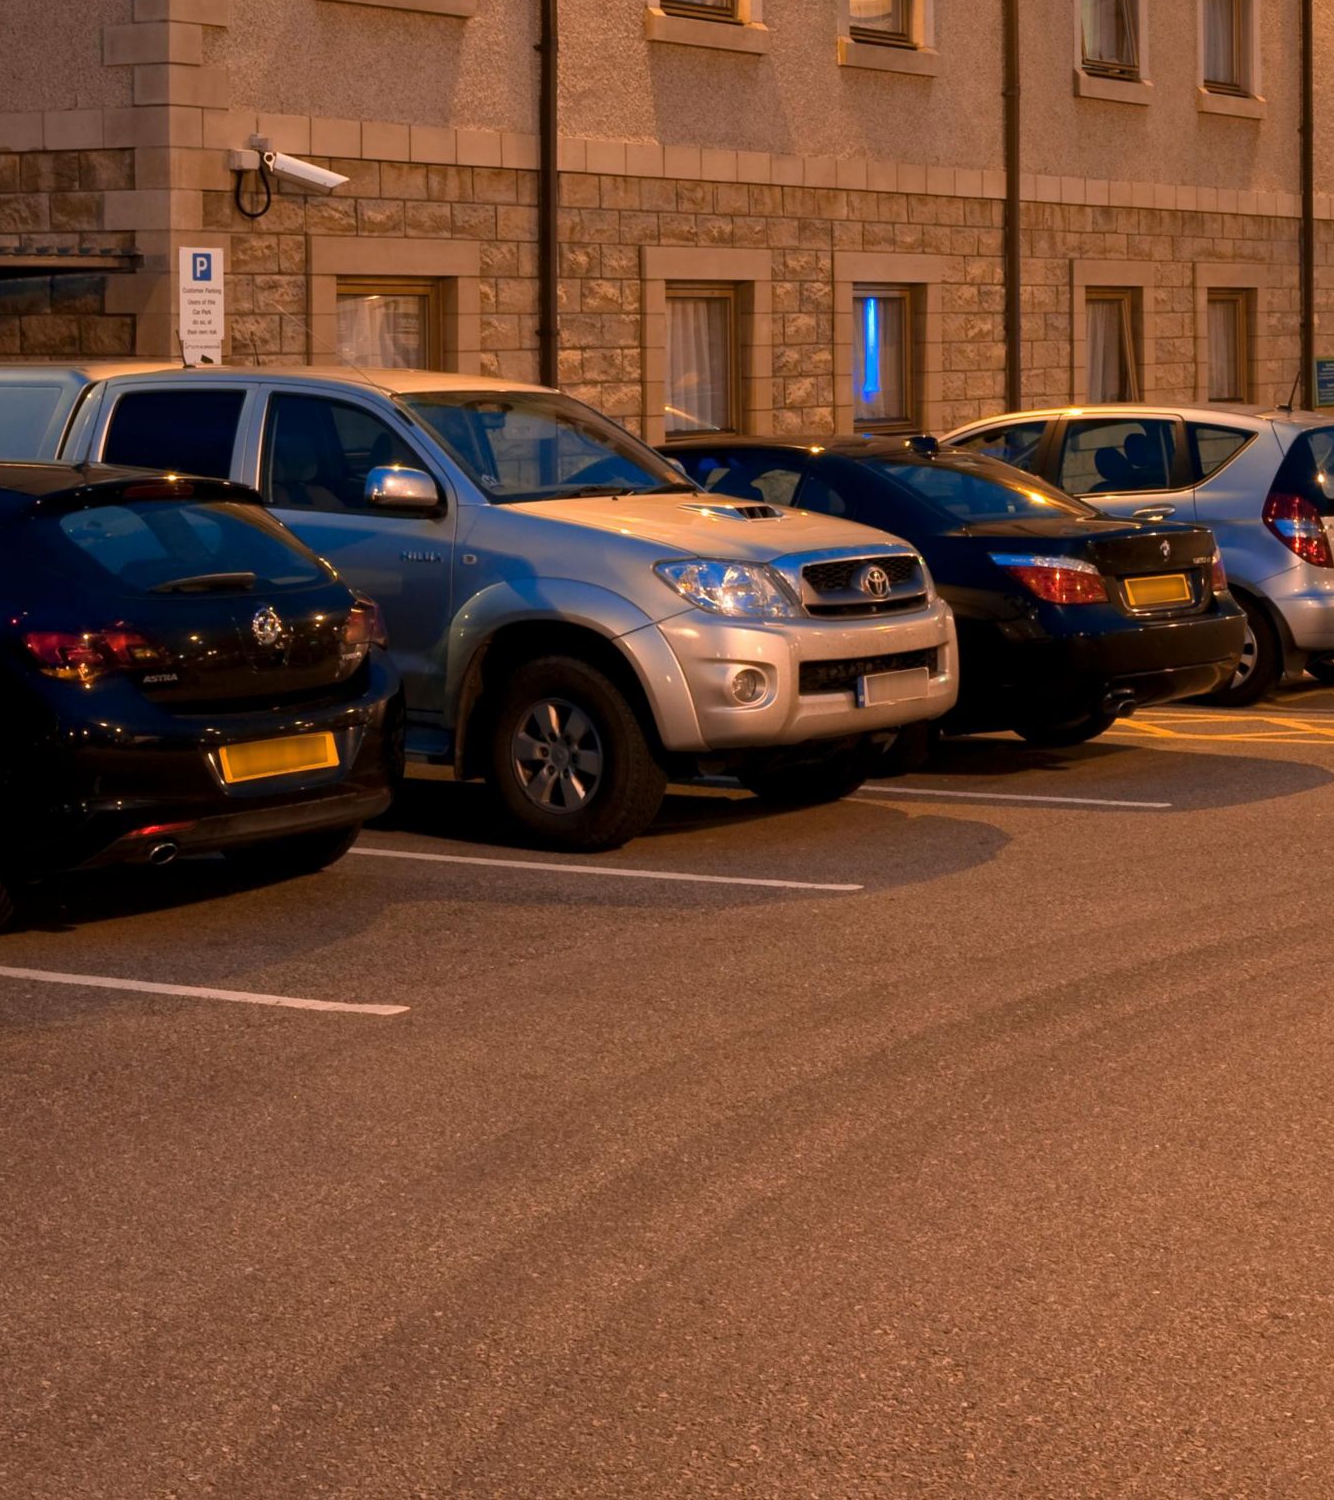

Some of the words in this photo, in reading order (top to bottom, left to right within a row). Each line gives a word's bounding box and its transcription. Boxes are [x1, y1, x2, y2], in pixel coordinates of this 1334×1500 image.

[196, 257, 208, 278] P
[205, 287, 222, 295] Parking
[401, 550, 444, 563] HILUX
[143, 673, 179, 684] ASTRA
